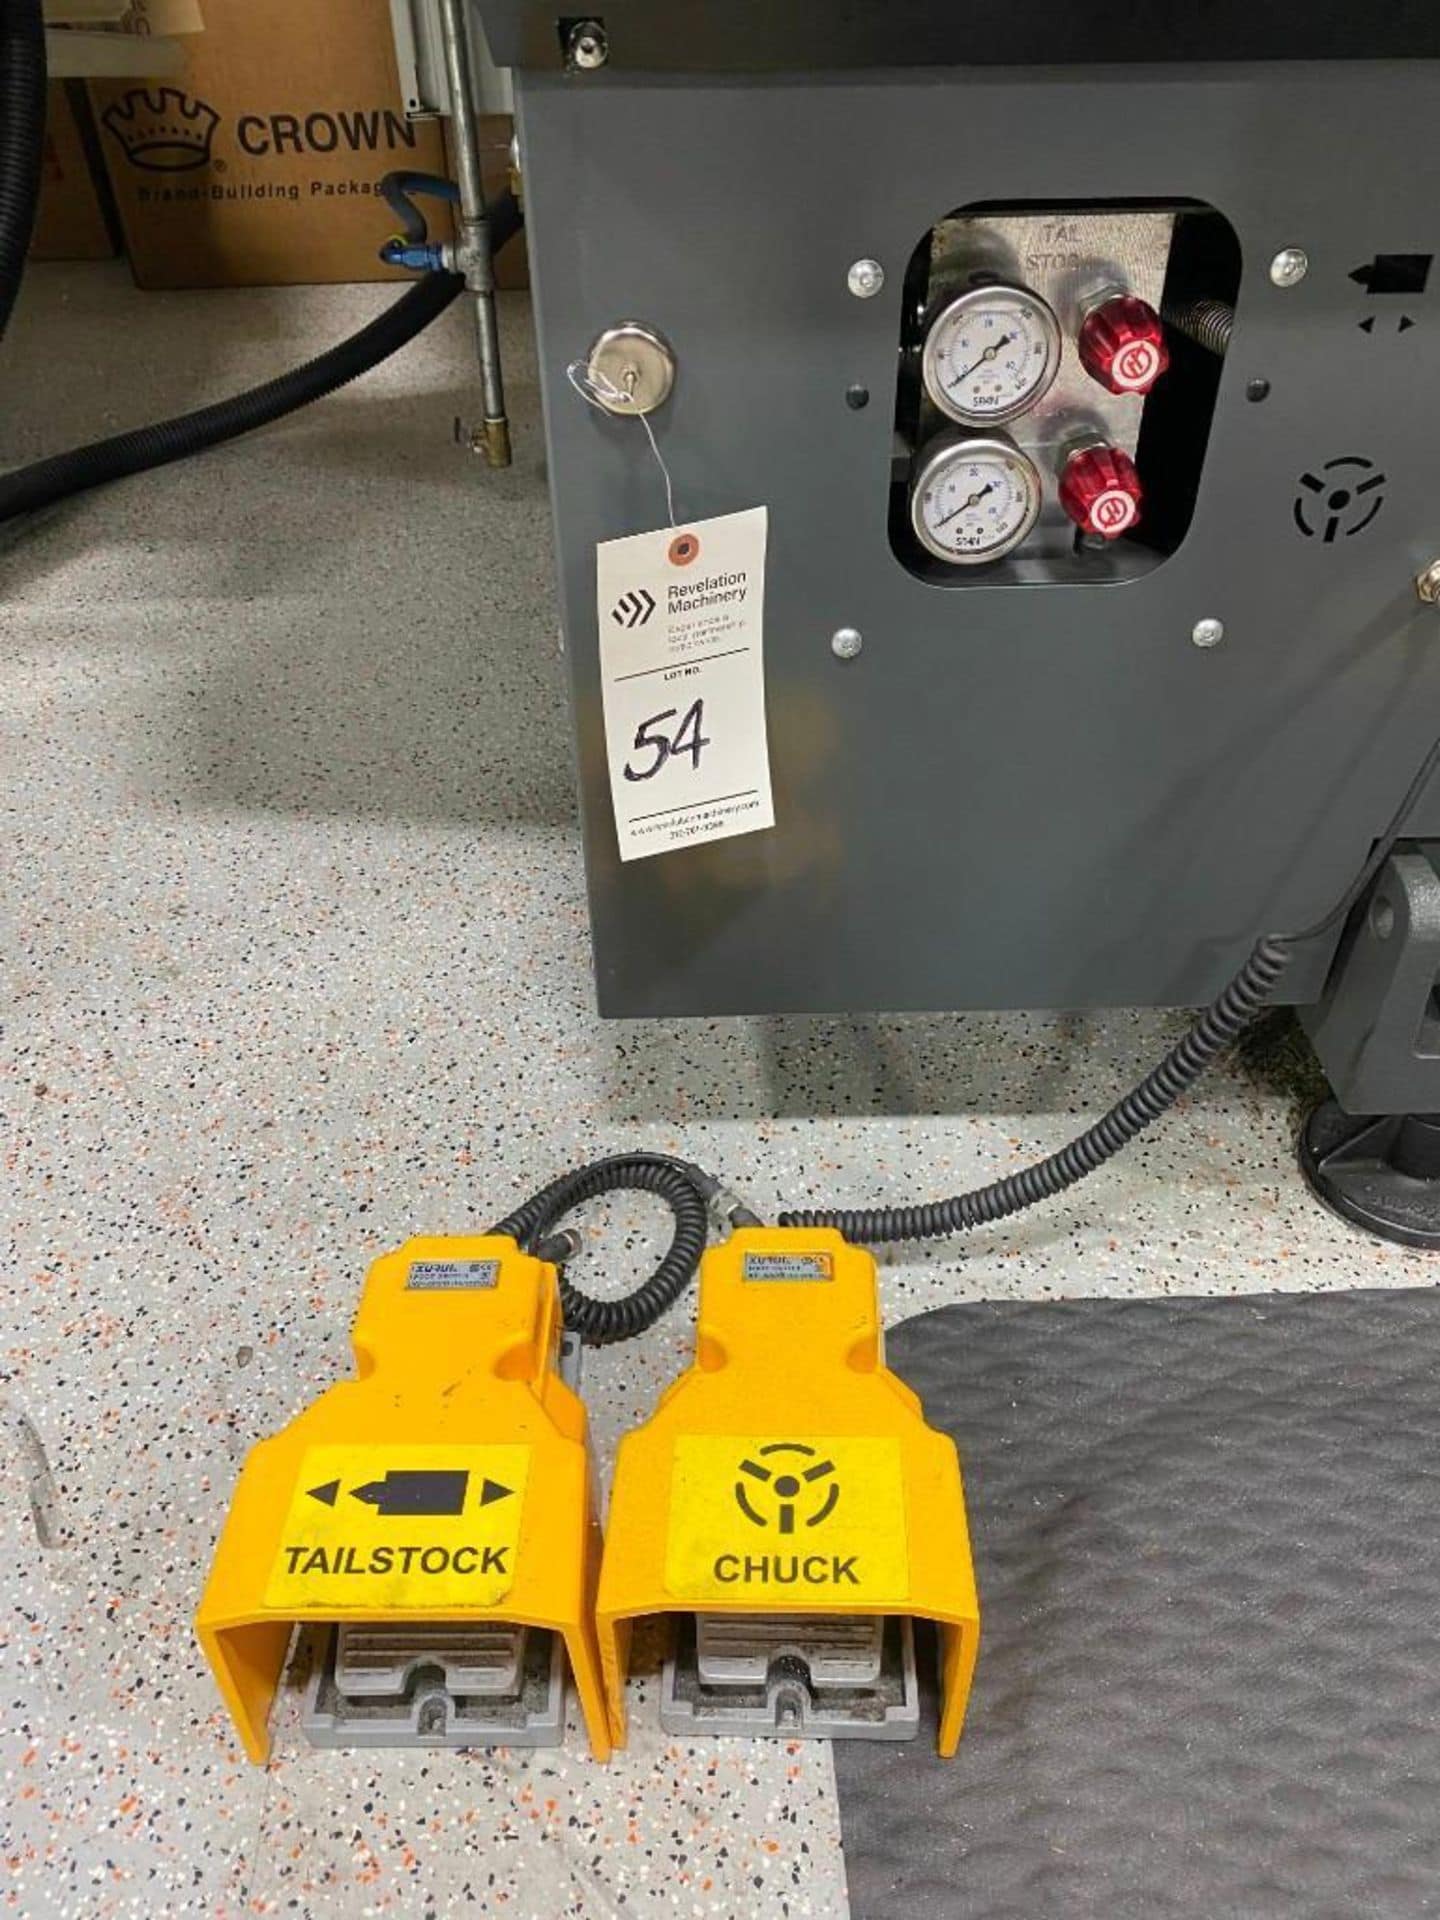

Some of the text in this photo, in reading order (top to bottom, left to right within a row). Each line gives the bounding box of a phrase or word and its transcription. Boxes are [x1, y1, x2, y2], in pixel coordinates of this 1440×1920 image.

[237, 110, 417, 155] CROWN
[138, 181, 386, 200] Brand-Building Packag
[668, 572, 747, 599] Revelation
[668, 588, 748, 615] Machinery
[664, 670, 682, 681] LOT
[624, 698, 711, 782] 54
[285, 1546, 511, 1575] TAILSTOCK
[713, 1554, 861, 1585] CHUCK
